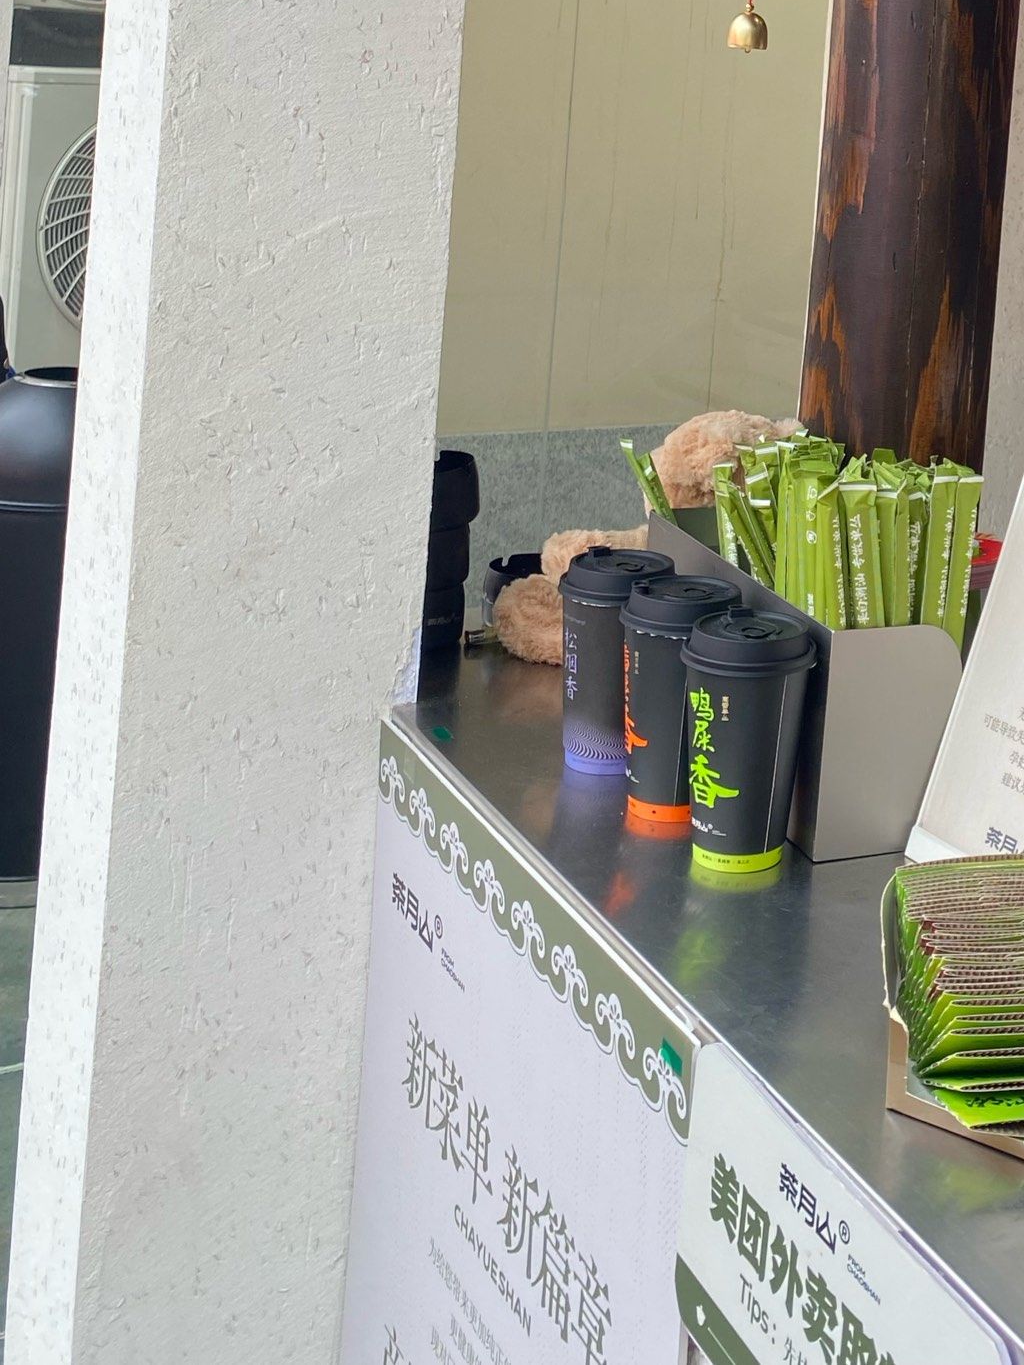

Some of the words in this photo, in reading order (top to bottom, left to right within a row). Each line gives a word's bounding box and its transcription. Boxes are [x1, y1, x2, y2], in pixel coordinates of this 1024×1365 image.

[689, 687, 740, 809] 鸭屎香
[392, 872, 434, 953] 茶月山
[401, 1012, 493, 1205] 新菜单
[453, 1203, 532, 1338] CHAYUESHAN
[709, 1152, 896, 1365] 美团外卖取
[779, 1162, 836, 1255] 茶月山
[428, 1236, 513, 1365] 为给您带来更加纯正
